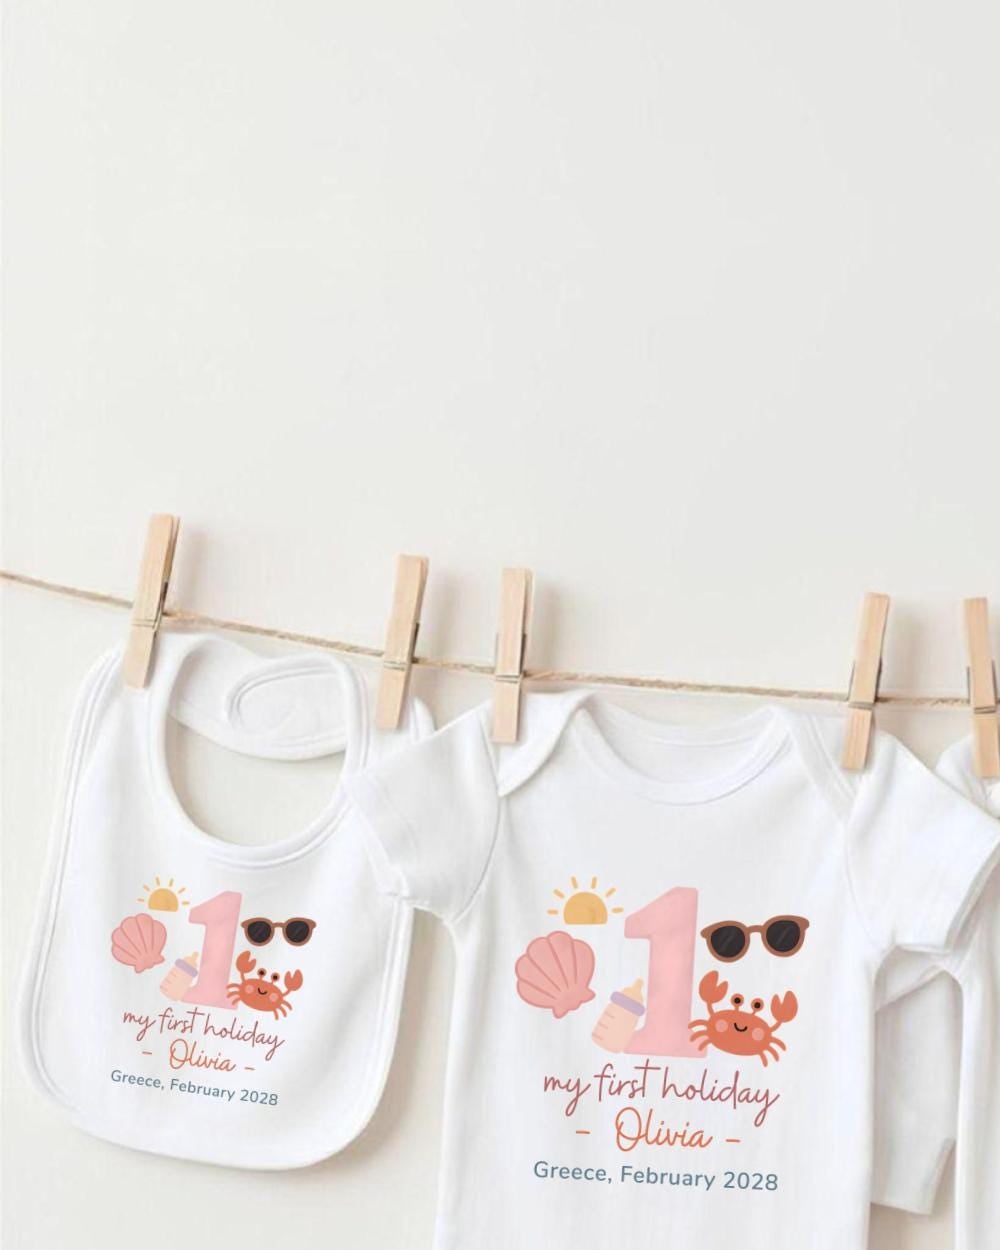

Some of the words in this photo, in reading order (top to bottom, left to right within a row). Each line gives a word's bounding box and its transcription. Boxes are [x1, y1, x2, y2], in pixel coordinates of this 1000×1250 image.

[188, 890, 243, 1010] 1
[623, 886, 709, 1058] 1
[123, 1009, 156, 1042] my
[158, 1007, 205, 1034] first
[204, 1014, 285, 1061] holiday
[169, 1038, 236, 1072] Olivia
[110, 1069, 165, 1091] Greece,
[170, 1078, 236, 1102] February
[239, 1089, 279, 1106] 2028
[543, 1074, 592, 1116] my
[593, 1058, 662, 1102] first
[661, 1066, 780, 1127] holiday
[615, 1106, 713, 1152] Olivia
[533, 1161, 613, 1184] Greece,
[620, 1166, 716, 1191] February
[723, 1171, 779, 1191] 2028
